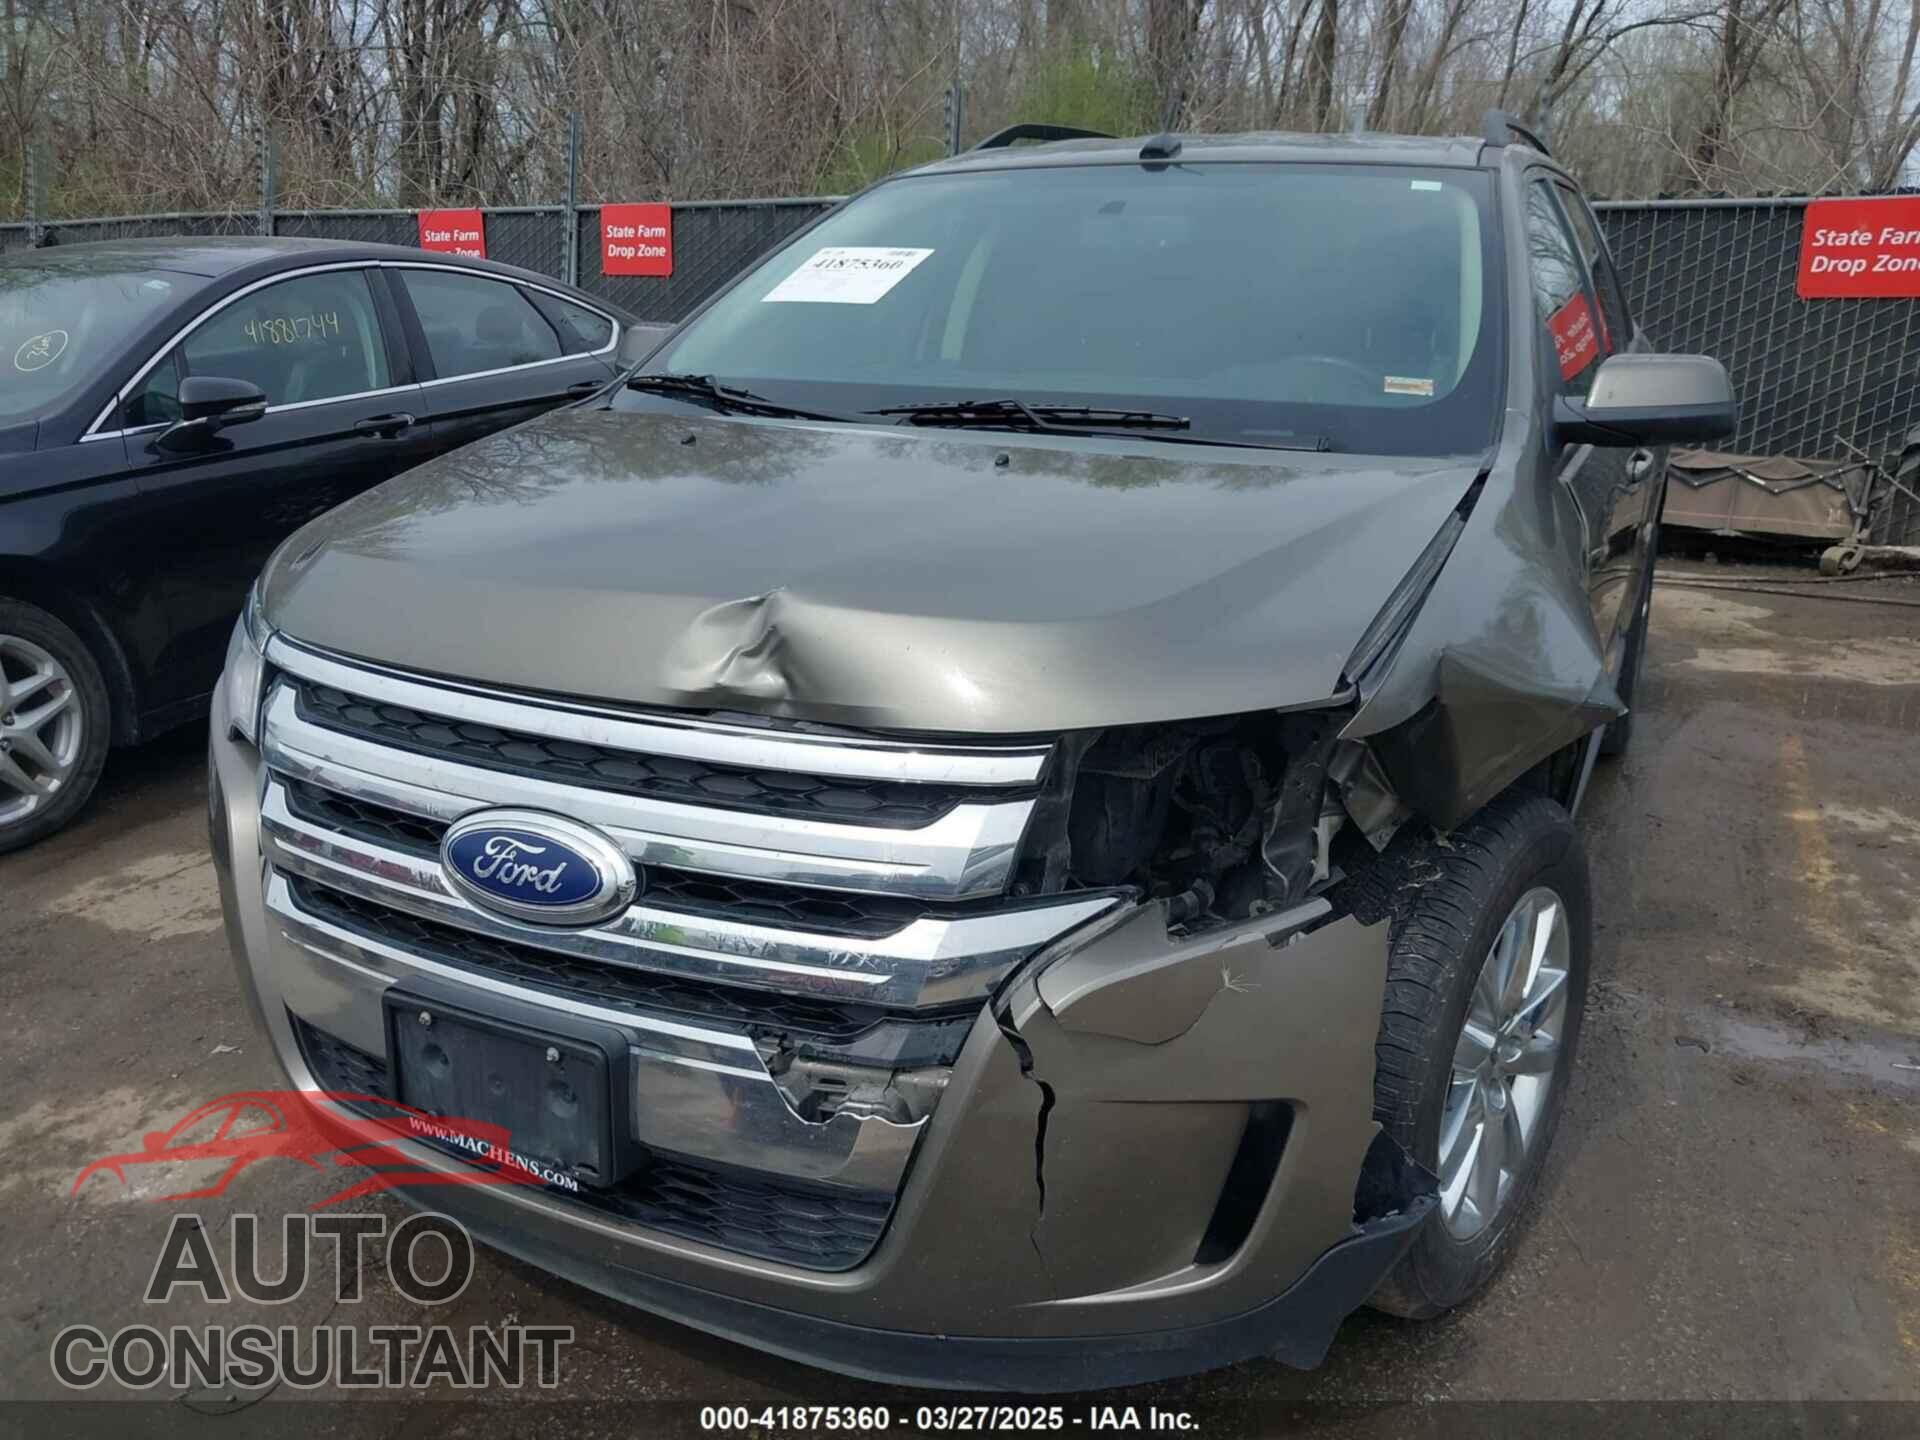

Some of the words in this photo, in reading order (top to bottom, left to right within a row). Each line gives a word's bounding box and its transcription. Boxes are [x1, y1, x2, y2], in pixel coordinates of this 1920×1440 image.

[425, 230, 450, 242] State
[453, 229, 480, 241] Farm
[606, 224, 635, 238] State
[638, 224, 666, 238] Farm
[1811, 229, 1873, 247] State
[608, 243, 635, 260] Drop
[637, 243, 666, 257] Zone
[1810, 255, 1867, 277] Drop
[1872, 254, 1920, 271] Zon
[244, 311, 340, 344] 41881744
[473, 836, 567, 893] Ford
[409, 1116, 579, 1192] WWW.MACHENS.COM
